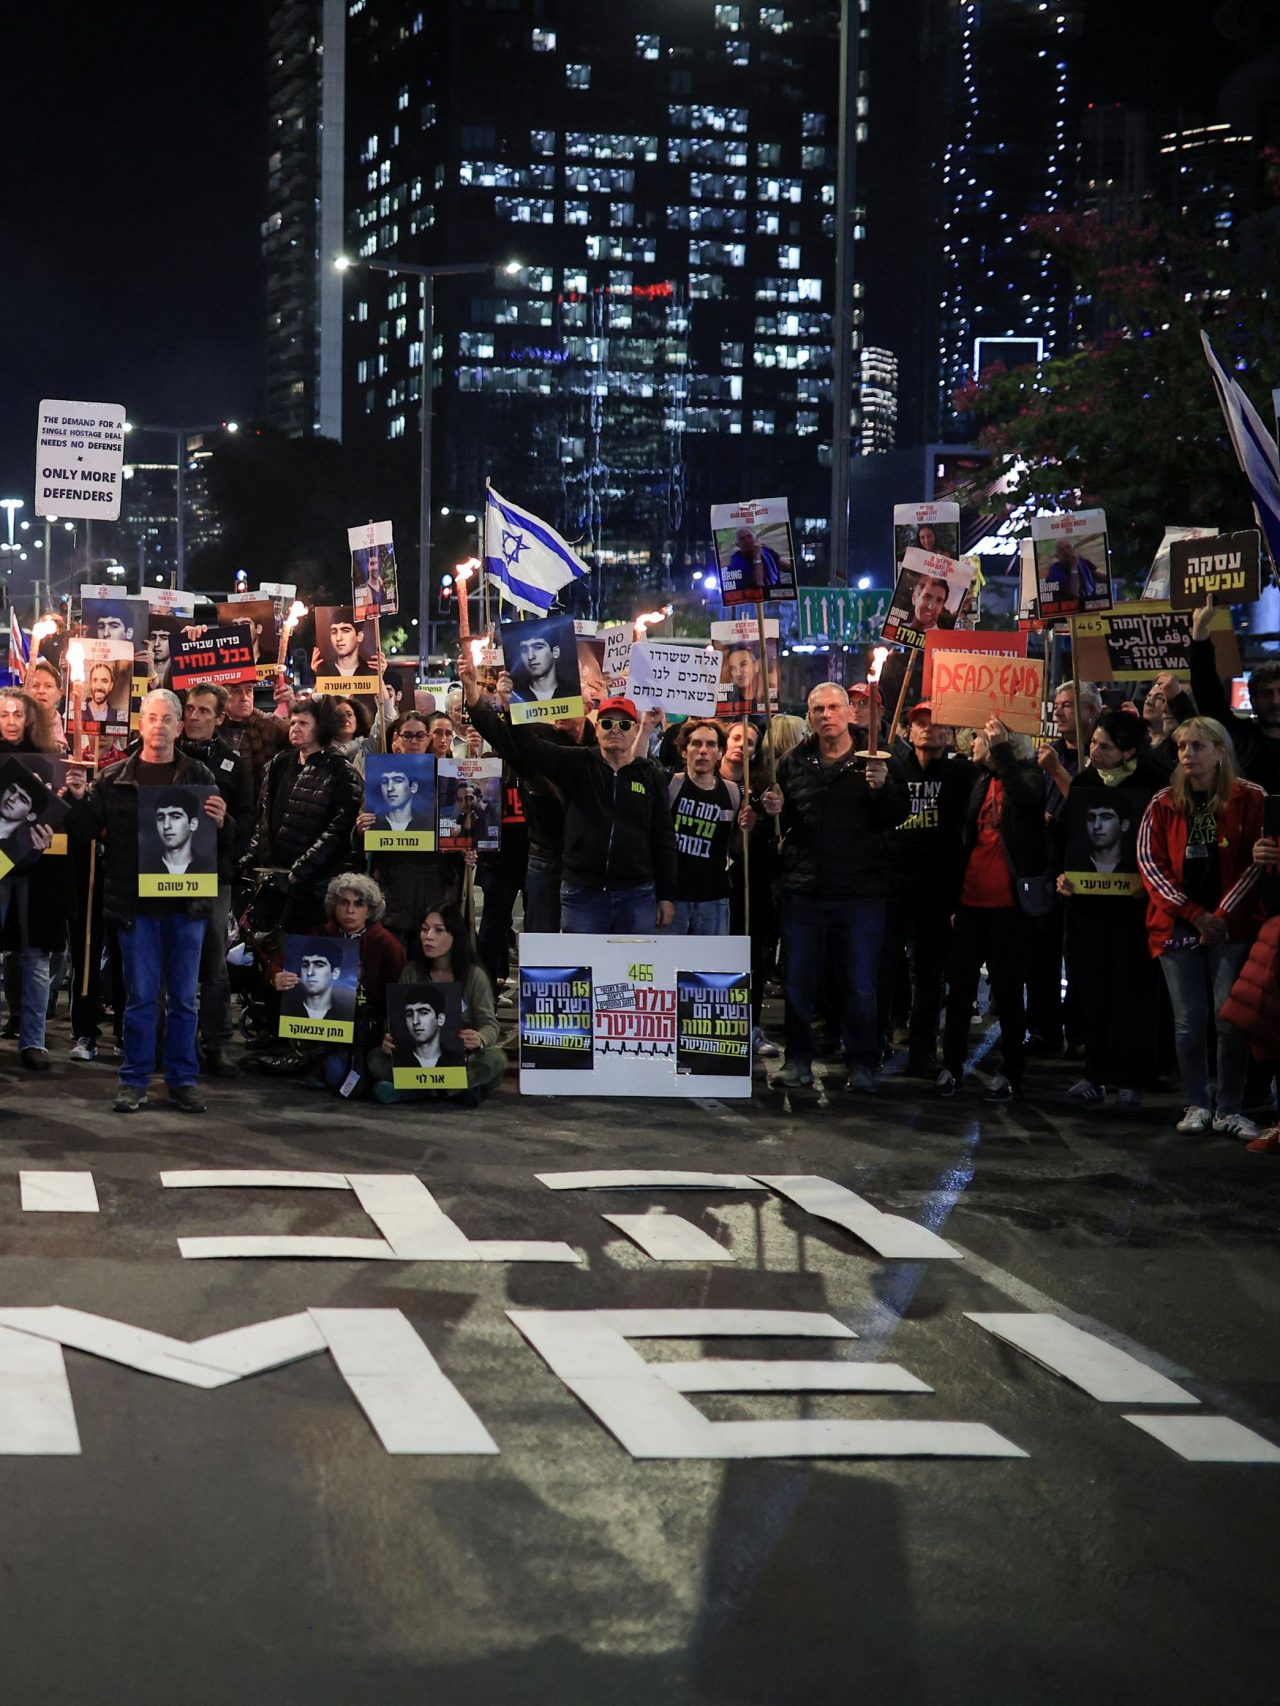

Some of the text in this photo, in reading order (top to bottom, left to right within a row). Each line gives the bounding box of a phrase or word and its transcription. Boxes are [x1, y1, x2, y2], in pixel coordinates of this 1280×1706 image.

[44, 416, 58, 424] THE
[62, 418, 96, 427] DEMAND
[99, 420, 114, 428] FOR
[42, 428, 67, 436] SINGLE
[70, 430, 102, 438] HOSTAGE
[40, 438, 122, 452] NEEDS NO DEFENSE
[42, 468, 116, 482] ONLY MORE
[44, 488, 113, 502] DEFENDERS
[1188, 552, 1241, 576] עסקה
[721, 570, 742, 581] BRING
[1184, 571, 1246, 594] עכשיו!
[722, 580, 736, 591] HIM
[1040, 581, 1060, 592] BRING
[890, 606, 909, 621] BRING
[887, 617, 900, 627] HIM
[1112, 614, 1189, 630] די למלחמה
[182, 636, 240, 650] פדיון שבויים
[608, 633, 624, 646] NO
[1156, 629, 1190, 648] وقف
[174, 646, 250, 668] בכל מחיר
[608, 644, 632, 658] MOR
[650, 650, 719, 666] אלה ששרדו
[1132, 646, 1168, 658] STOP
[612, 660, 630, 672] WA
[1134, 656, 1190, 670] THE WA
[188, 672, 242, 684] #עסקה עכשיו!
[652, 666, 716, 684] מחכים לנו
[936, 663, 994, 694] DEAD
[633, 684, 715, 702] בשארית כוחם
[718, 682, 734, 692] RING
[526, 704, 569, 718] שגב כלפון
[924, 782, 942, 798] MY
[678, 797, 720, 822] למה הם
[440, 818, 456, 828] BRING
[674, 814, 716, 838] עדיין
[900, 809, 938, 830] OME!
[440, 828, 450, 837] HIM
[380, 838, 419, 848] נמרוד כהן
[157, 880, 199, 892] טל שוהם
[1080, 880, 1130, 890] אלי שרעבי
[628, 964, 654, 982] 465
[522, 982, 589, 998] 15 חודשים
[680, 988, 746, 1002] 15 חודשים
[536, 998, 590, 1014] בשבי הם
[634, 986, 676, 1012] כולם
[693, 1004, 748, 1019] בשבי הם
[525, 1013, 591, 1030] סכנת מוות
[596, 1013, 676, 1038] הומניטרי
[682, 1019, 748, 1036] סכנת מוות
[289, 1024, 344, 1038] מתן צנגאוקר
[416, 1074, 445, 1084] אור לוי
